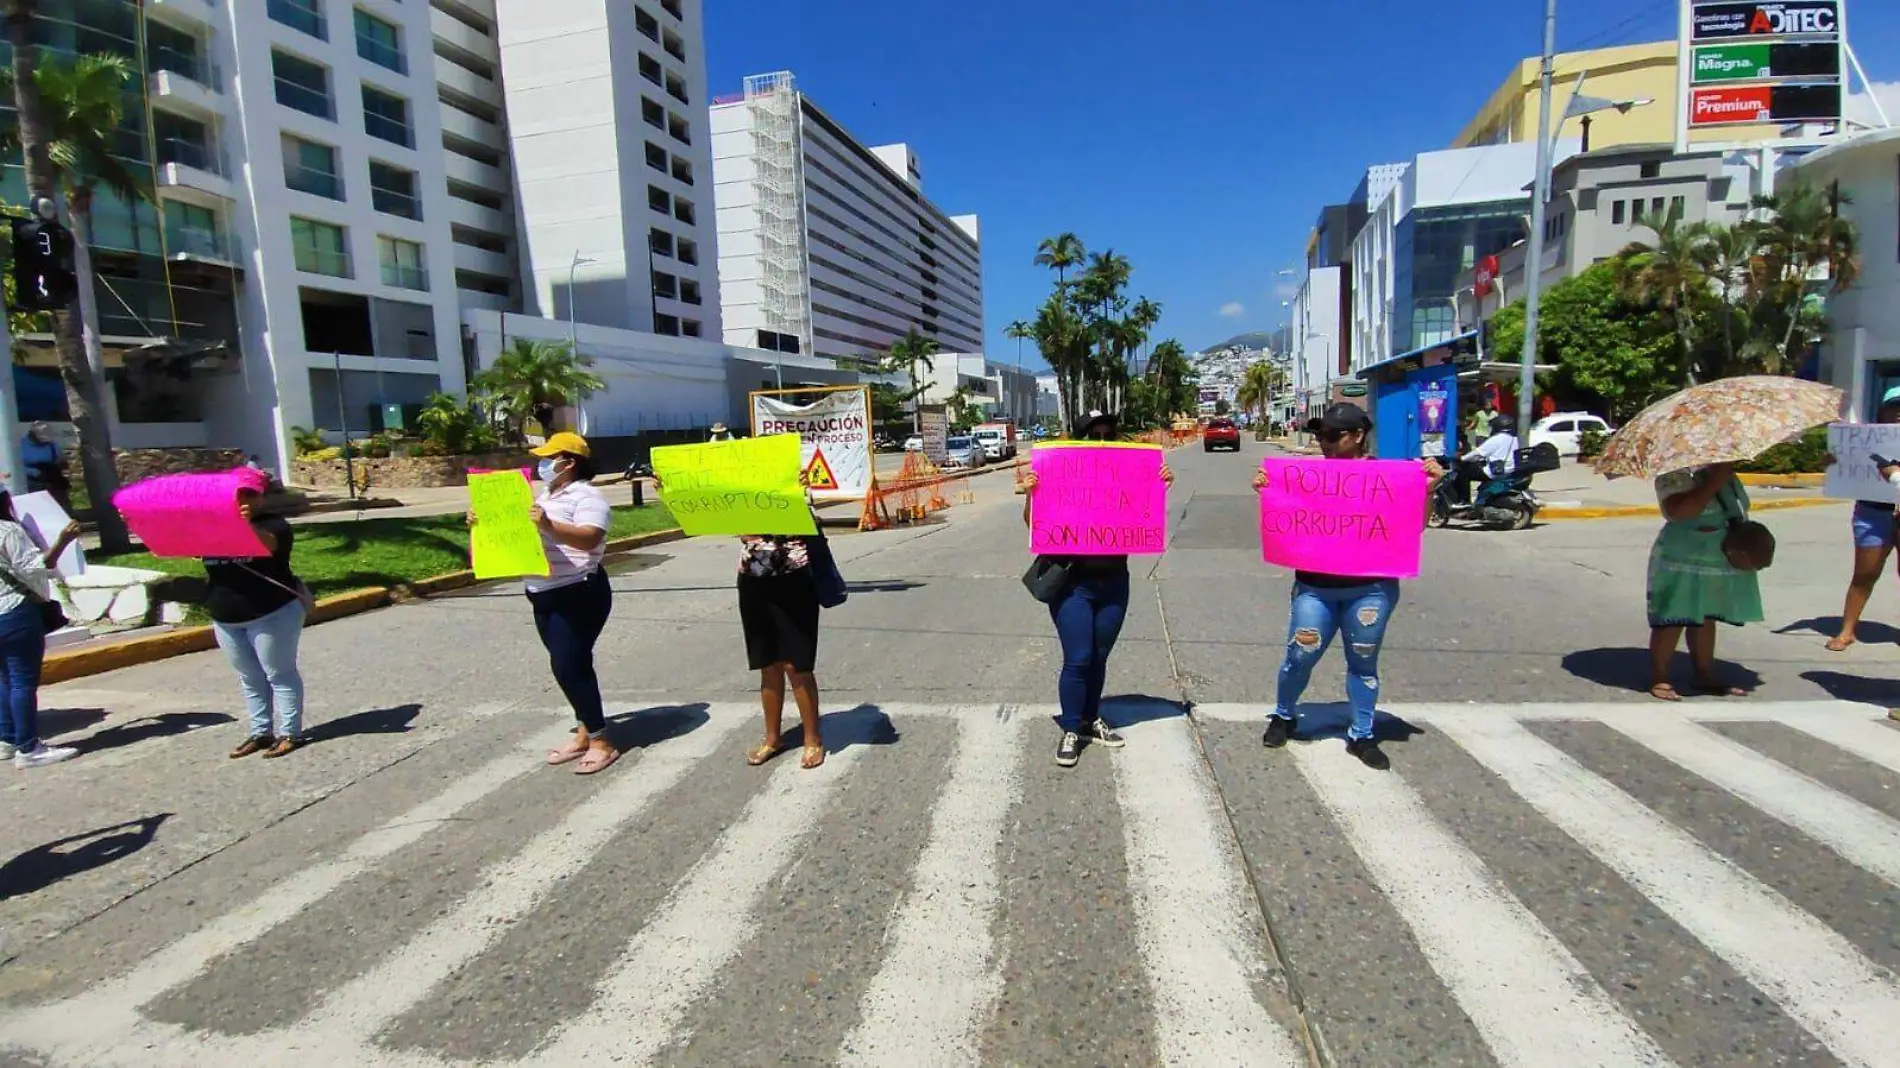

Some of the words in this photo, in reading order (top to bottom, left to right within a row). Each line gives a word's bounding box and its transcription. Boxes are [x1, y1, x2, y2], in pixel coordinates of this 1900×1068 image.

[762, 414, 863, 433] PRECAUCIÓN
[818, 434, 863, 444] PROCESO
[1283, 464, 1394, 503] POLICIA
[1033, 520, 1079, 547] SON
[1263, 508, 1389, 542] CORRUPTA
